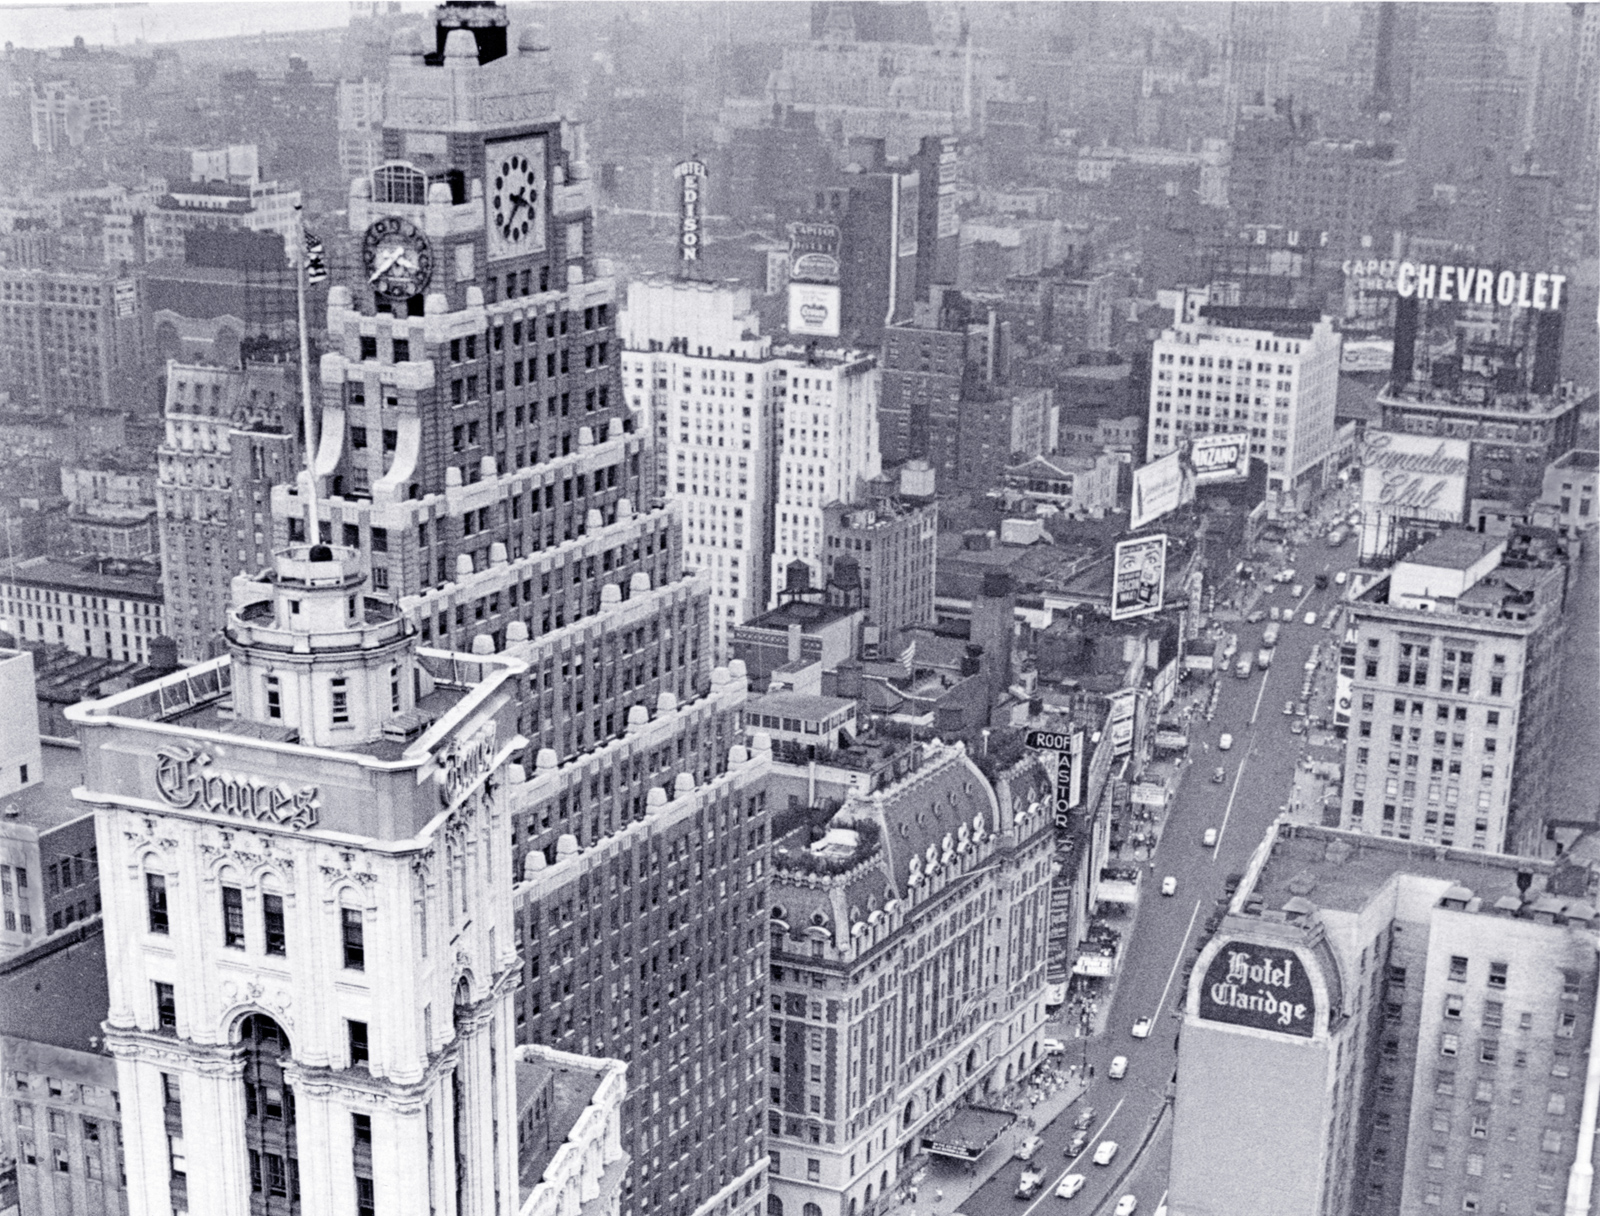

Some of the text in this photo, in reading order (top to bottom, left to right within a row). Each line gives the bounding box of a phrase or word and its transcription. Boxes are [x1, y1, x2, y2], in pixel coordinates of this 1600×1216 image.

[683, 175, 698, 261] EDISON
[1397, 262, 1566, 310] CHEVROLET
[1197, 446, 1238, 467] INZANO
[1379, 469, 1447, 508] Club
[1036, 732, 1070, 750] ROOF
[155, 744, 320, 831] Times
[1055, 755, 1071, 828] ASTOR
[1226, 951, 1293, 988] Hotel
[1211, 982, 1307, 1025] Claridge
